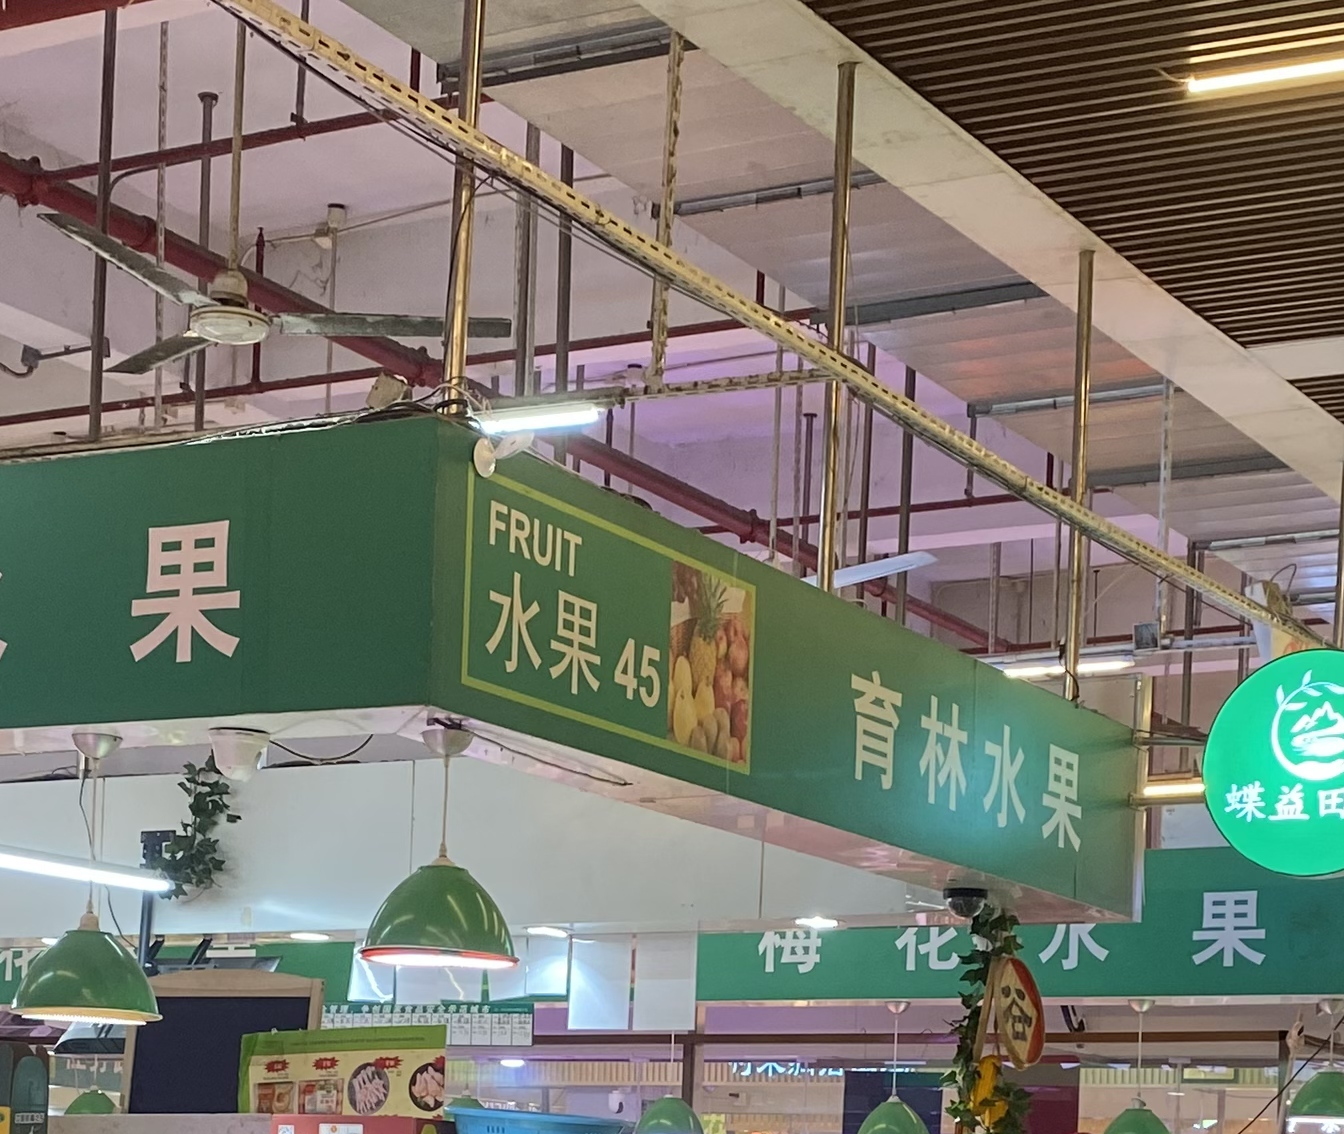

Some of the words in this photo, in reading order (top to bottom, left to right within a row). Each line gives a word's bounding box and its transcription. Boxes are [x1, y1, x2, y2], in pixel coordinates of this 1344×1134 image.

[488, 503, 582, 578] FRUIT
[484, 572, 601, 694] 水果
[613, 637, 662, 708] 45
[850, 669, 1084, 852] 育林水果
